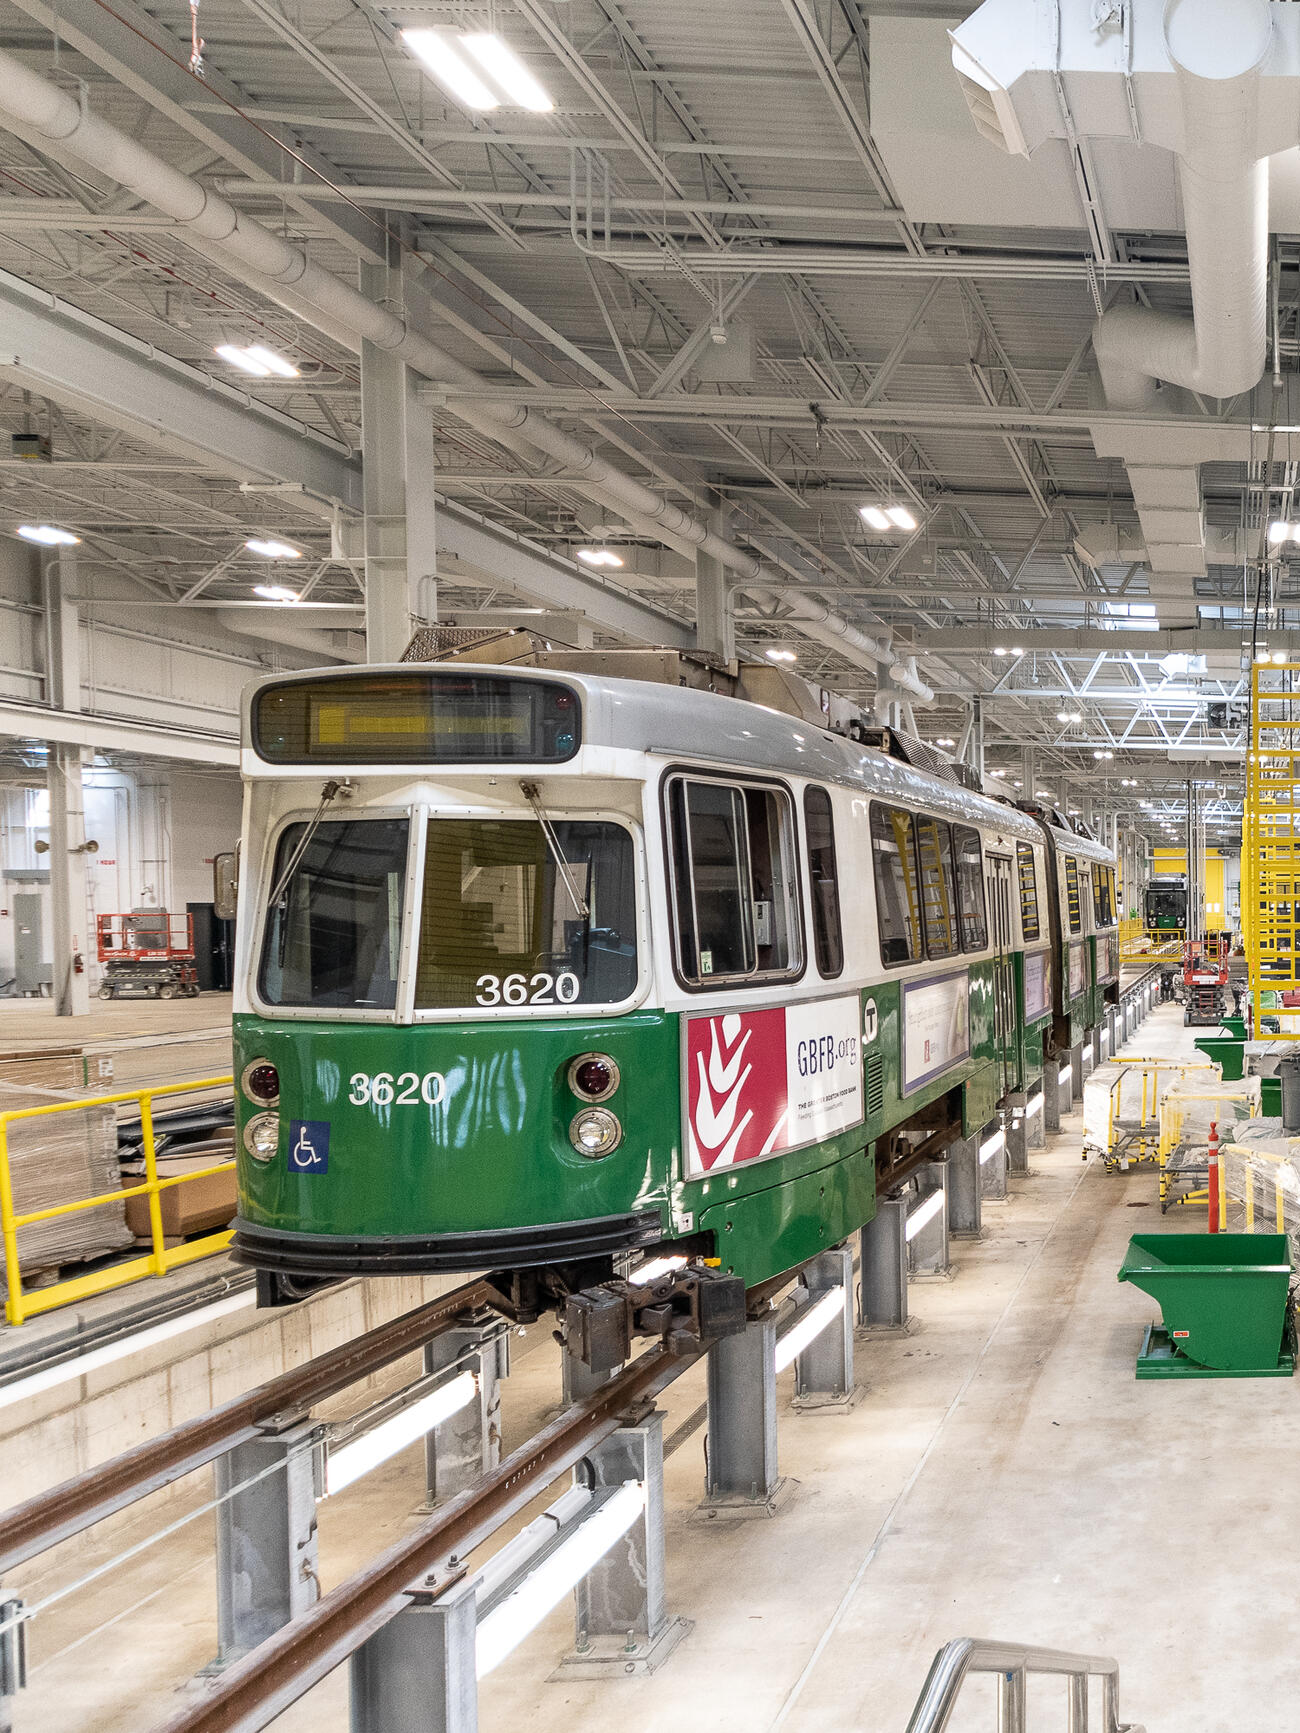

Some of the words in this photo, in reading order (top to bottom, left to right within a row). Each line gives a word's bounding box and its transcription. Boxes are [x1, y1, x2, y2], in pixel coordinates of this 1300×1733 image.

[475, 972, 580, 1006] 3620
[866, 1007, 876, 1034] T
[797, 1035, 857, 1077] GBFB.org
[348, 1072, 446, 1106] 3620
